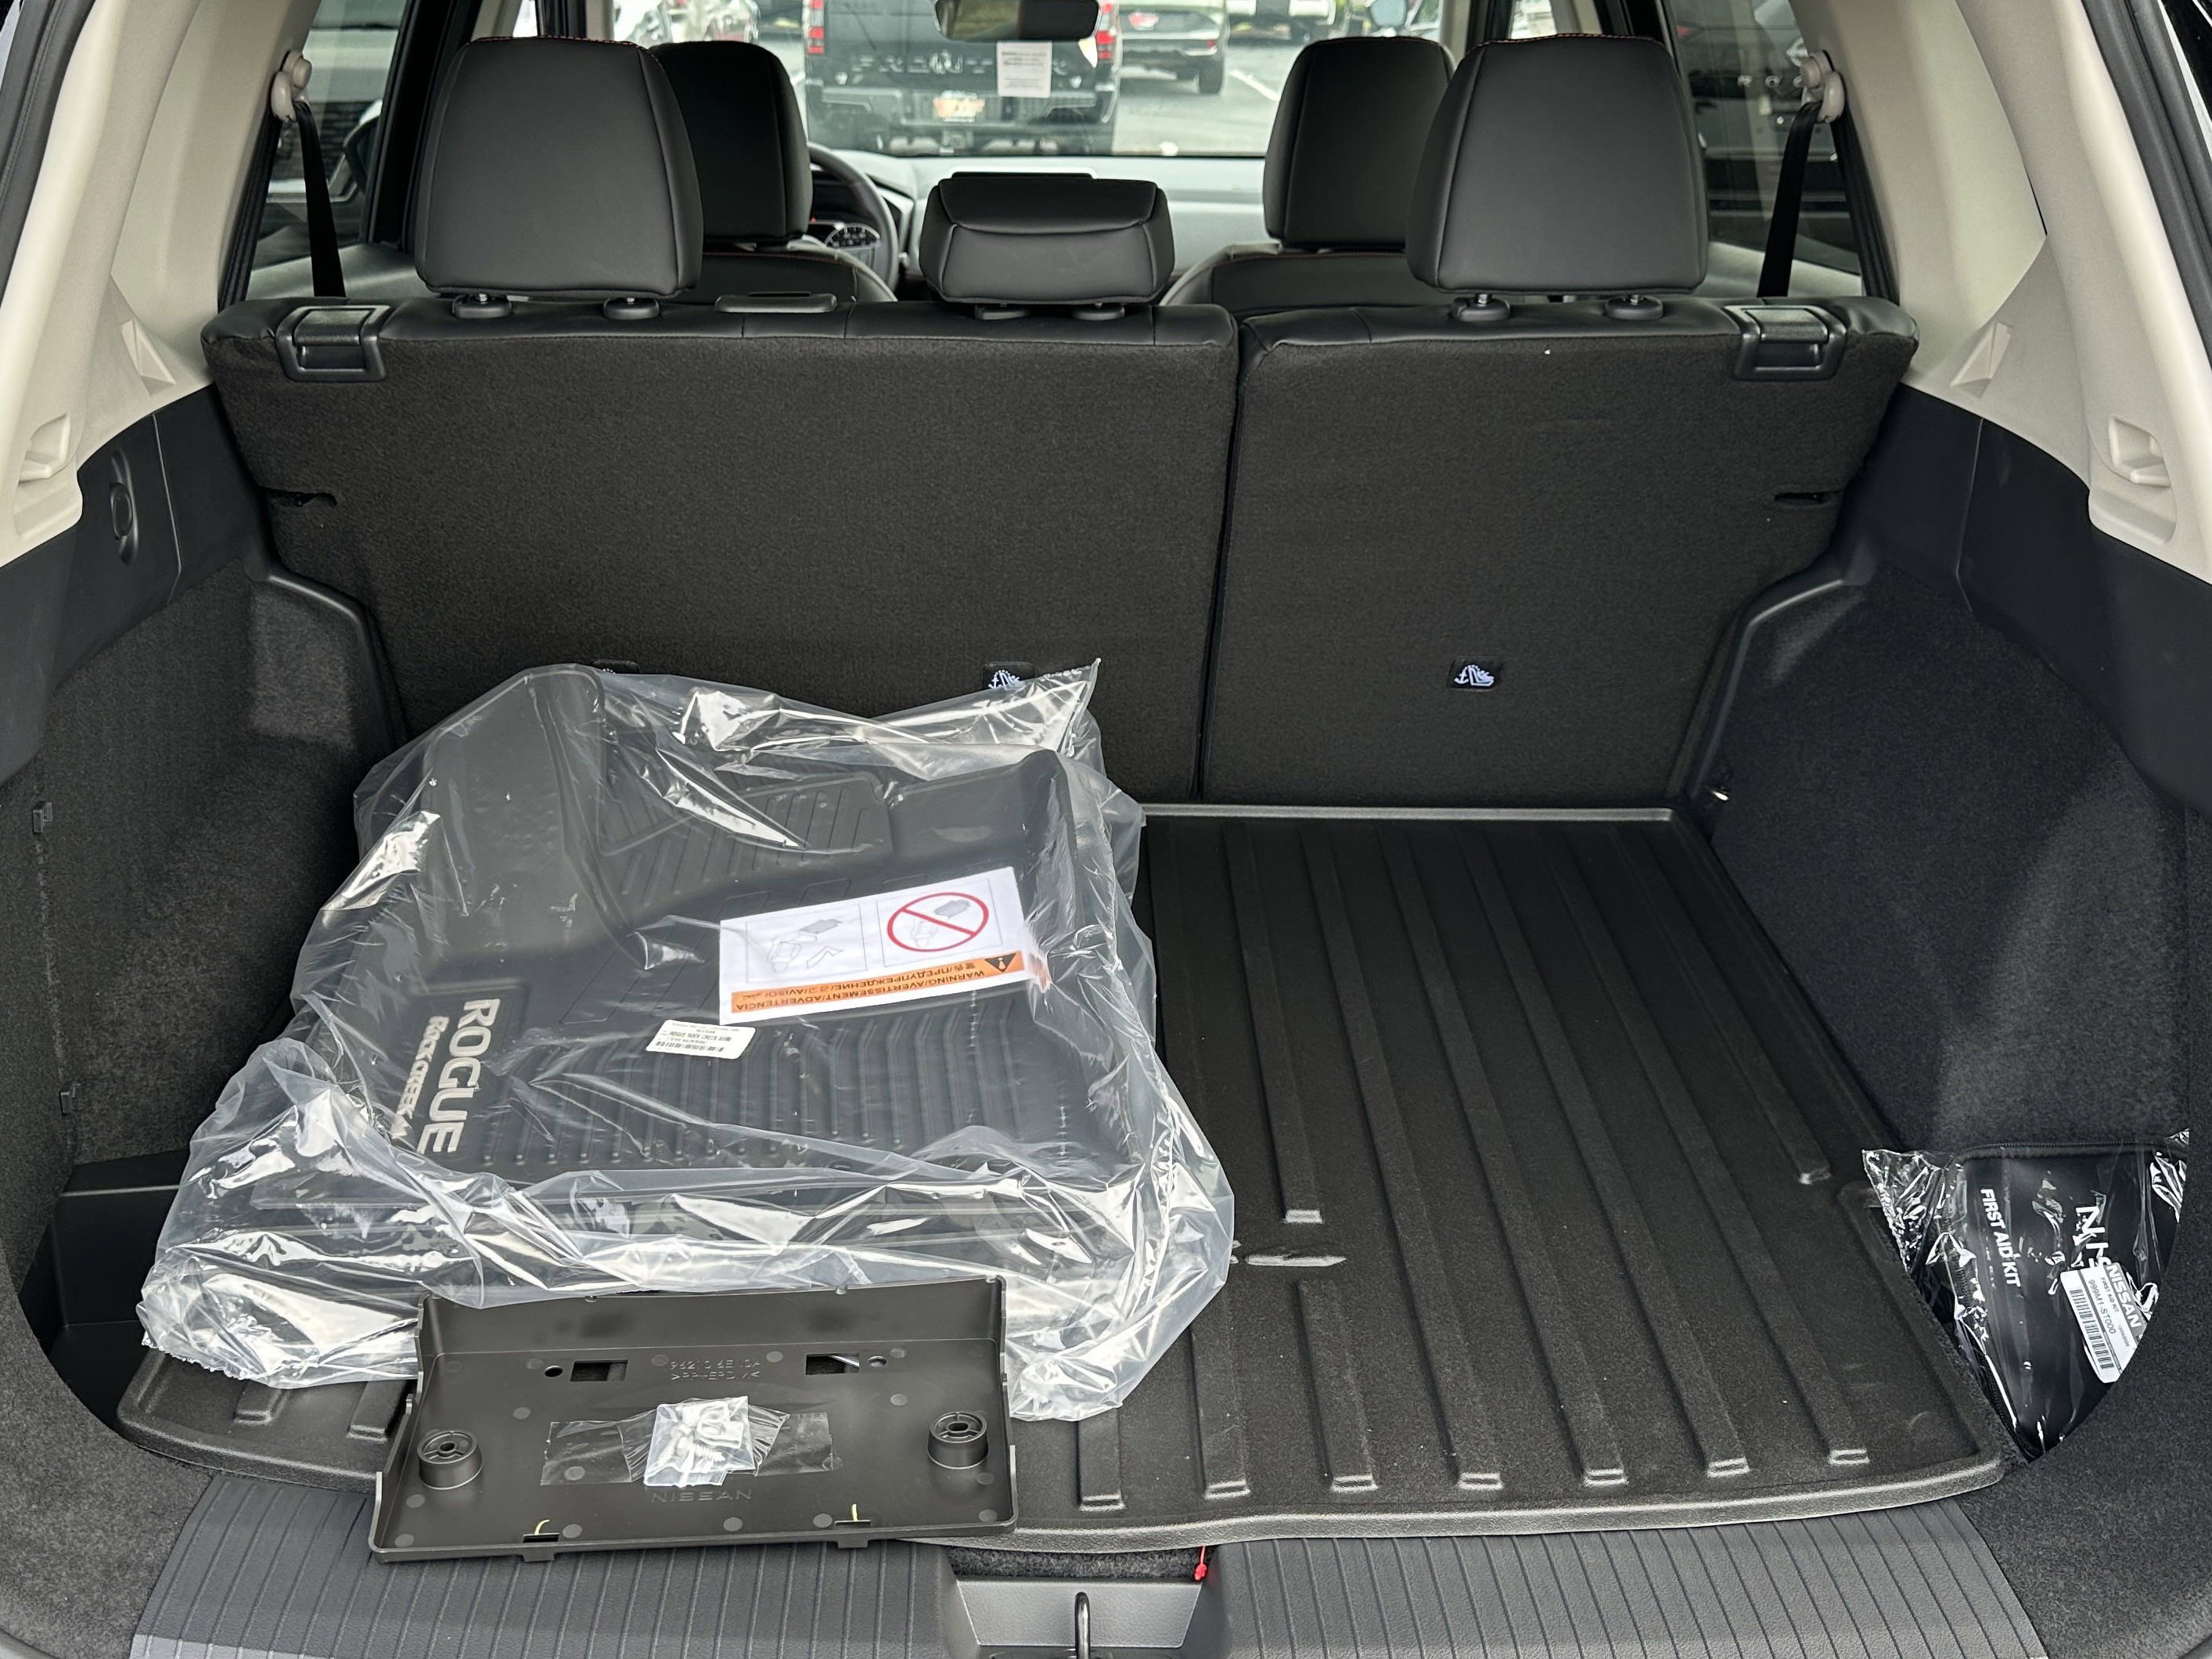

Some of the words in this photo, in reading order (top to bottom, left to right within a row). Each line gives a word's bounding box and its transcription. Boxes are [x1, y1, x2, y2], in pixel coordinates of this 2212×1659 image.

[415, 999, 501, 1155] ROGUE
[1980, 1189, 2006, 1229] FIRST
[1993, 1231, 2014, 1259] AID
[2002, 1261, 2021, 1287] KIT
[2106, 1264, 2142, 1329] NISSAN
[650, 1489, 753, 1503] NISSAN
